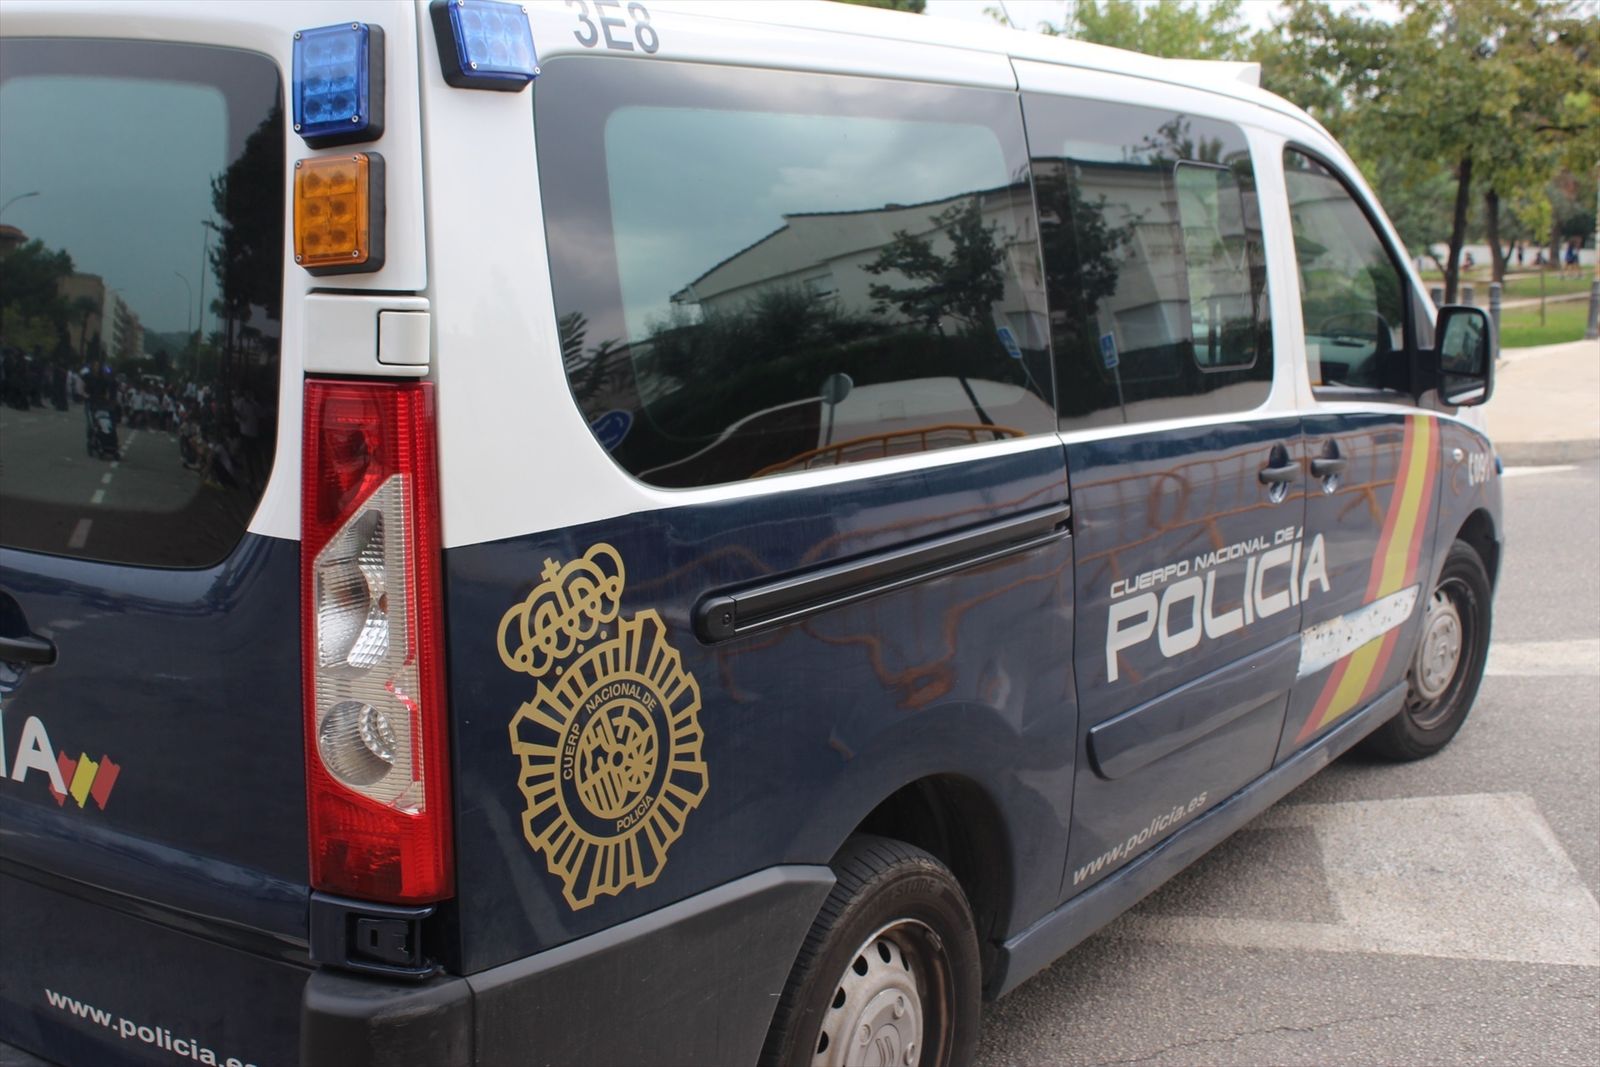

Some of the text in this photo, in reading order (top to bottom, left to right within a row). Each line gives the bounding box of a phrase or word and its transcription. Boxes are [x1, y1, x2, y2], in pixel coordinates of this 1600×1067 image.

[565, 0, 659, 54] 3E8
[1110, 526, 1295, 598] CUERPO NACIONAL DE
[1106, 526, 1331, 683] POLICÍA
[585, 683, 642, 714] NACIONAL
[642, 692, 657, 713] DE
[1073, 791, 1208, 886] www.policia.es
[45, 989, 257, 1067] www.policia.e
